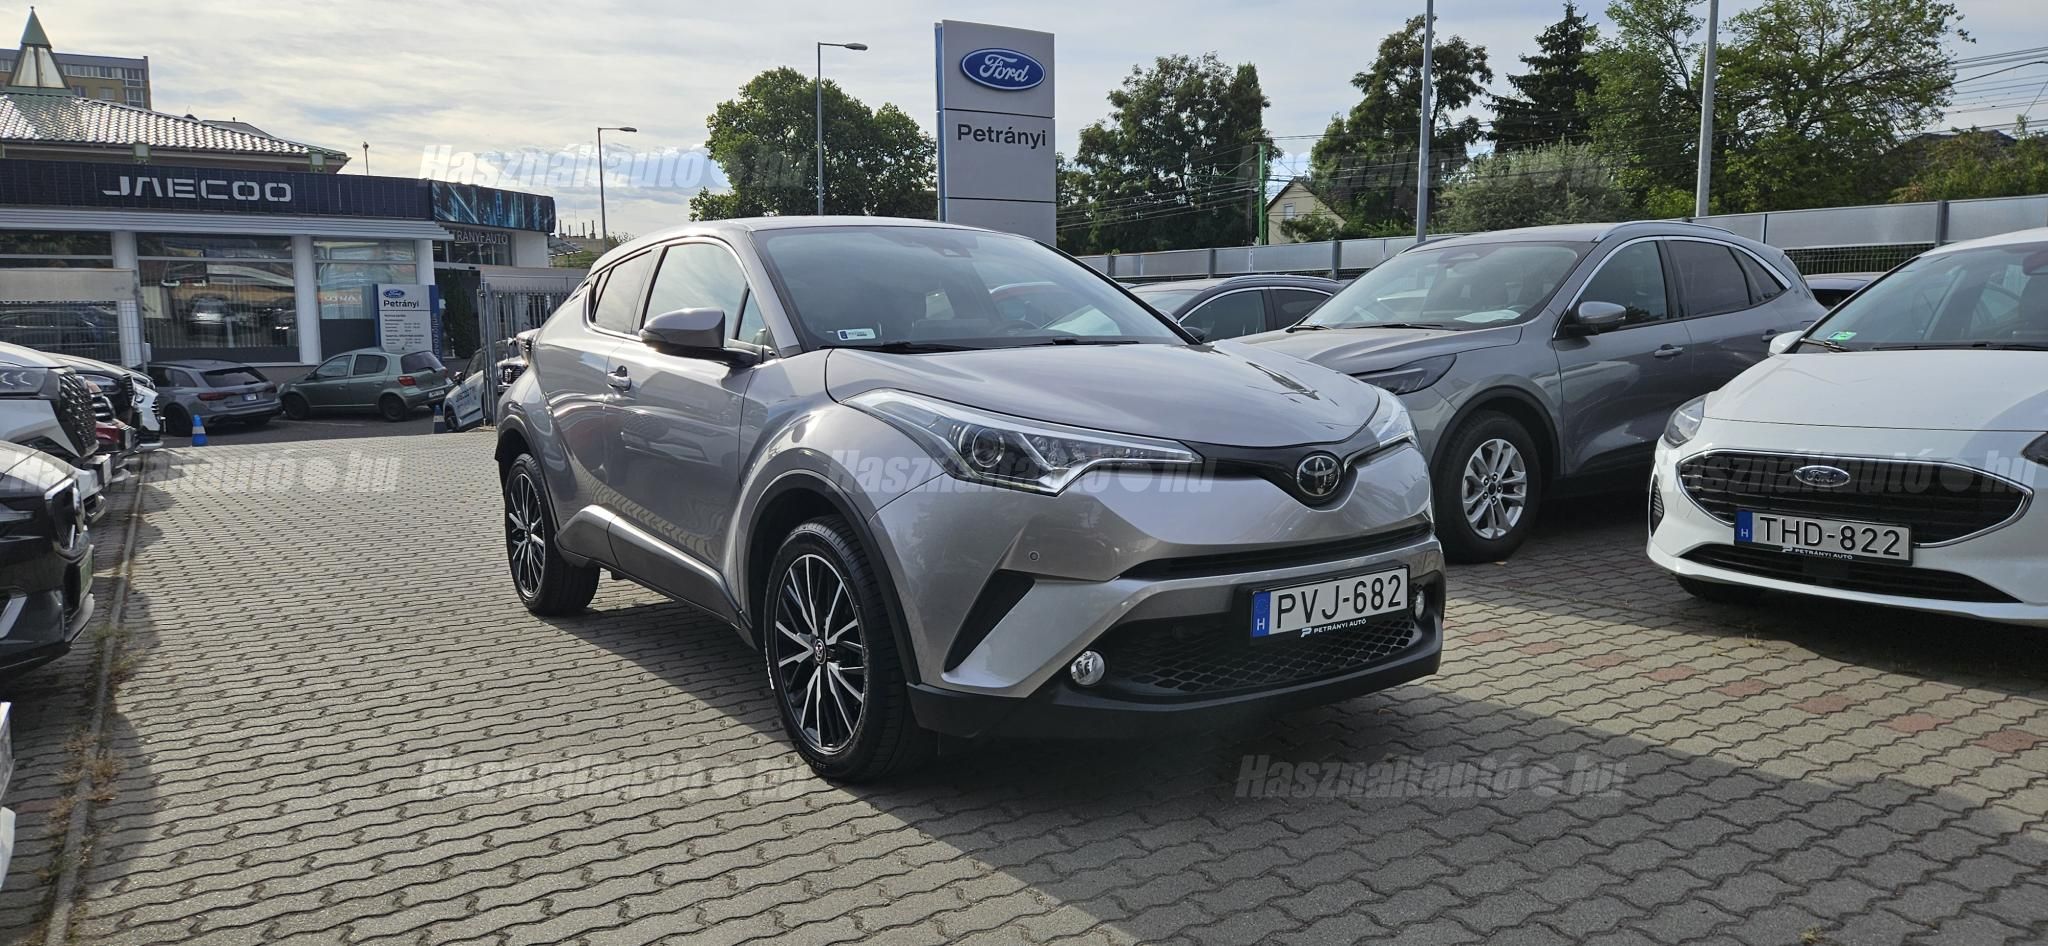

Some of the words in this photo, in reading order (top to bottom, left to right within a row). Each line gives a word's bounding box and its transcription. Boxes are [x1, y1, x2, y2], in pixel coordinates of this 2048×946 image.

[979, 54, 1030, 82] Ford
[957, 123, 1047, 150] Petrányi
[102, 175, 292, 202] JAECOO
[383, 299, 420, 309] Petrányi
[1740, 528, 1750, 538] H
[1759, 516, 1901, 557] THD-822
[1256, 617, 1266, 631] H
[1276, 574, 1402, 629] PVJ-682
[1313, 621, 1349, 634] PETRÁNYI
